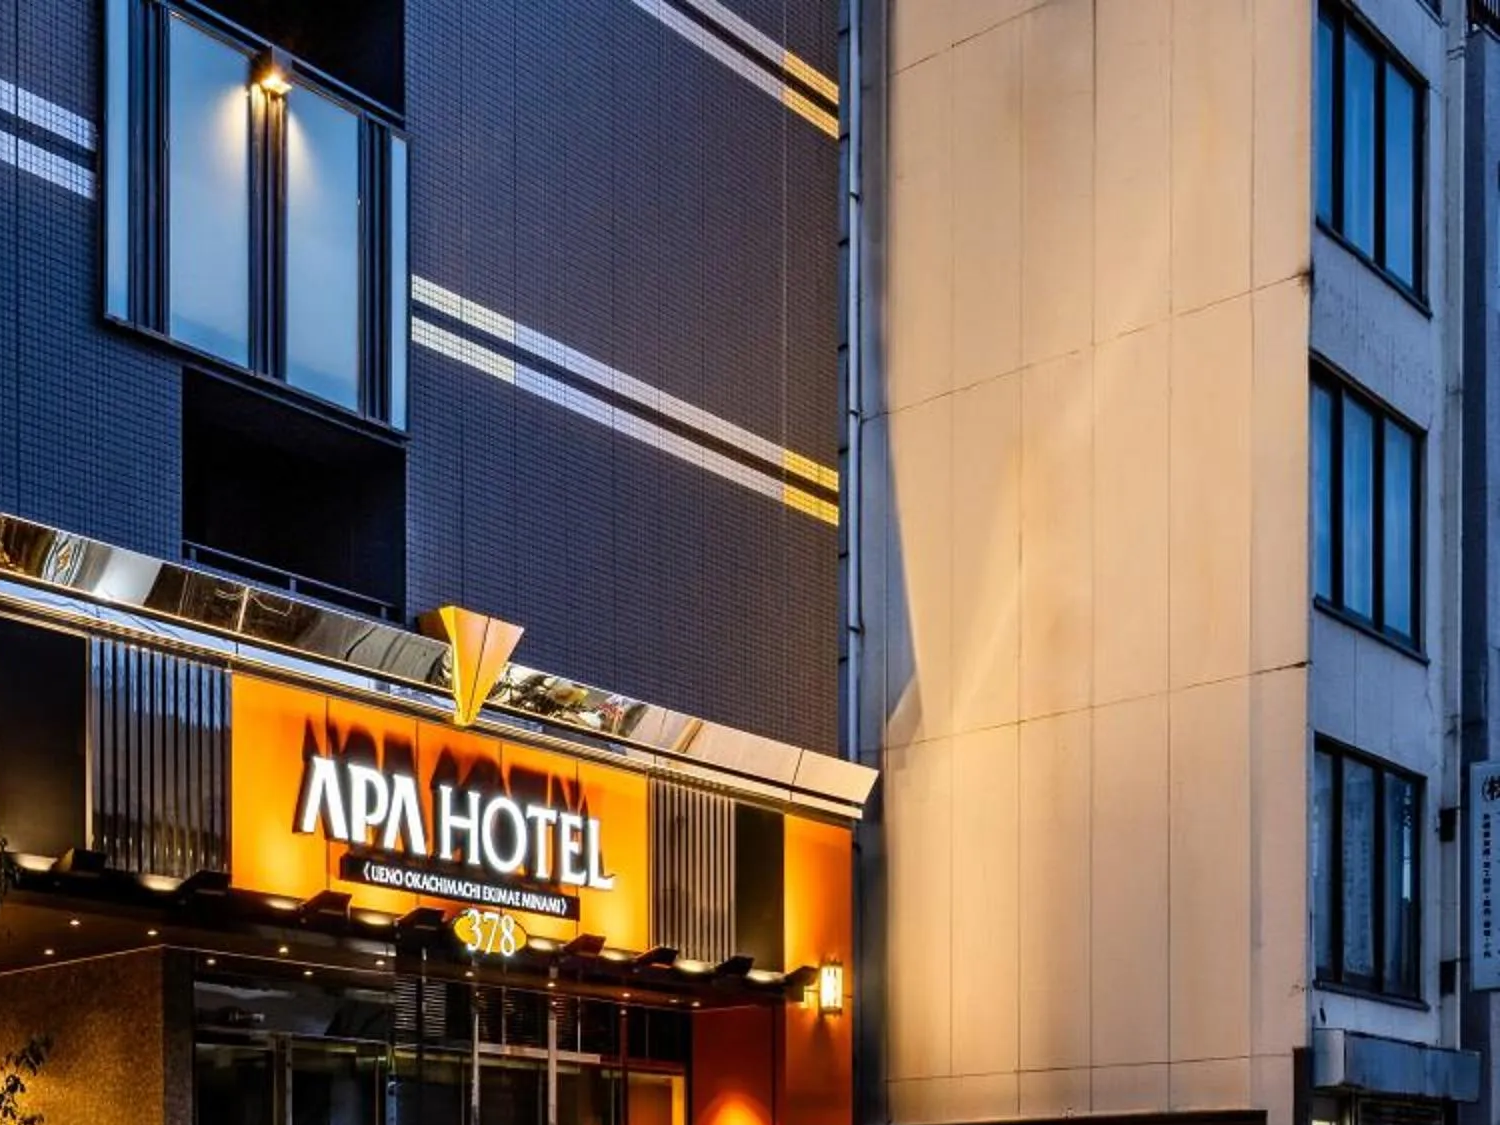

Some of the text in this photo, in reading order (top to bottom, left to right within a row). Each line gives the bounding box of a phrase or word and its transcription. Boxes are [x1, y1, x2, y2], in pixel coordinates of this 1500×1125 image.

[302, 755, 615, 890] APA HOTEL
[405, 871, 481, 899] OKACHIMACHI
[465, 907, 517, 957] 378
